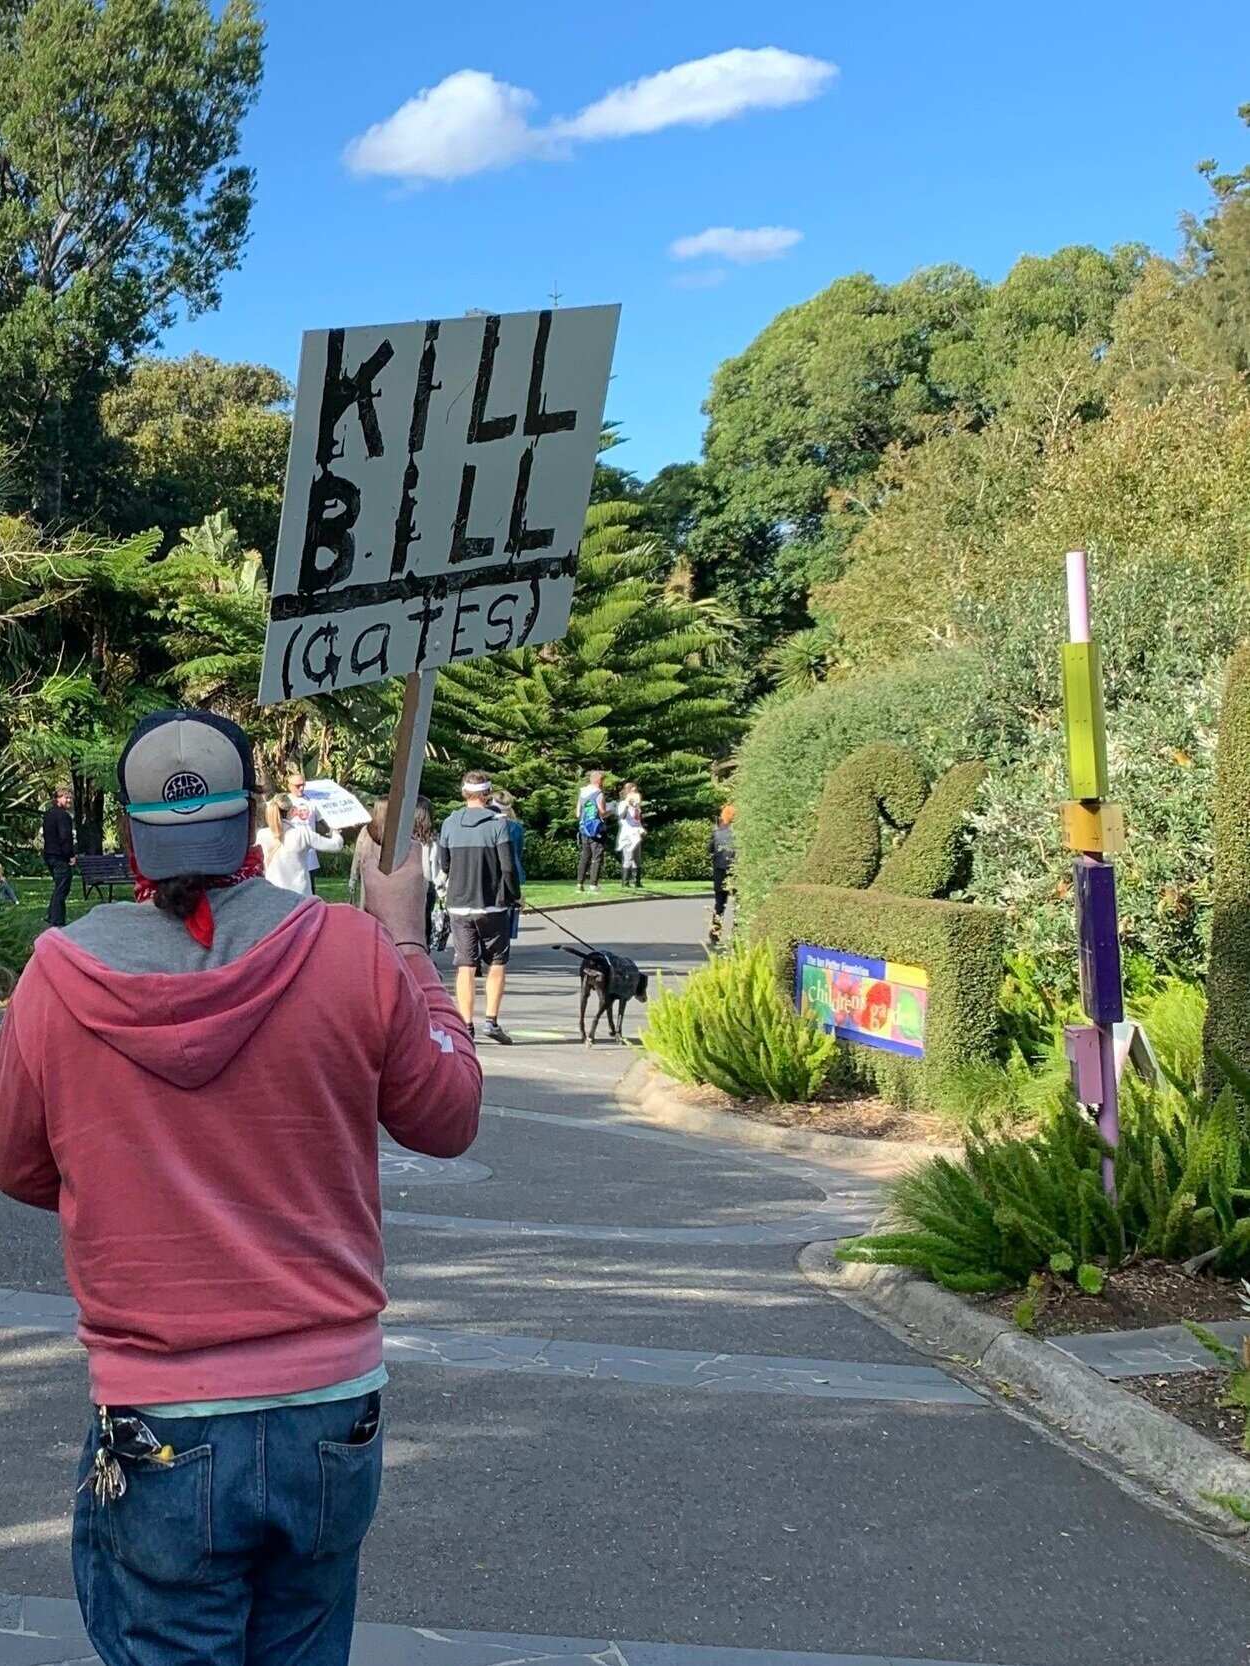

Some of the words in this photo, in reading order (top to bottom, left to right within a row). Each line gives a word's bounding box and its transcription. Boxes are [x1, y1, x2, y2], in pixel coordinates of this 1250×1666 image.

[316, 310, 577, 466] KILL
[298, 443, 556, 596] BILL
[167, 775, 199, 790] RIP
